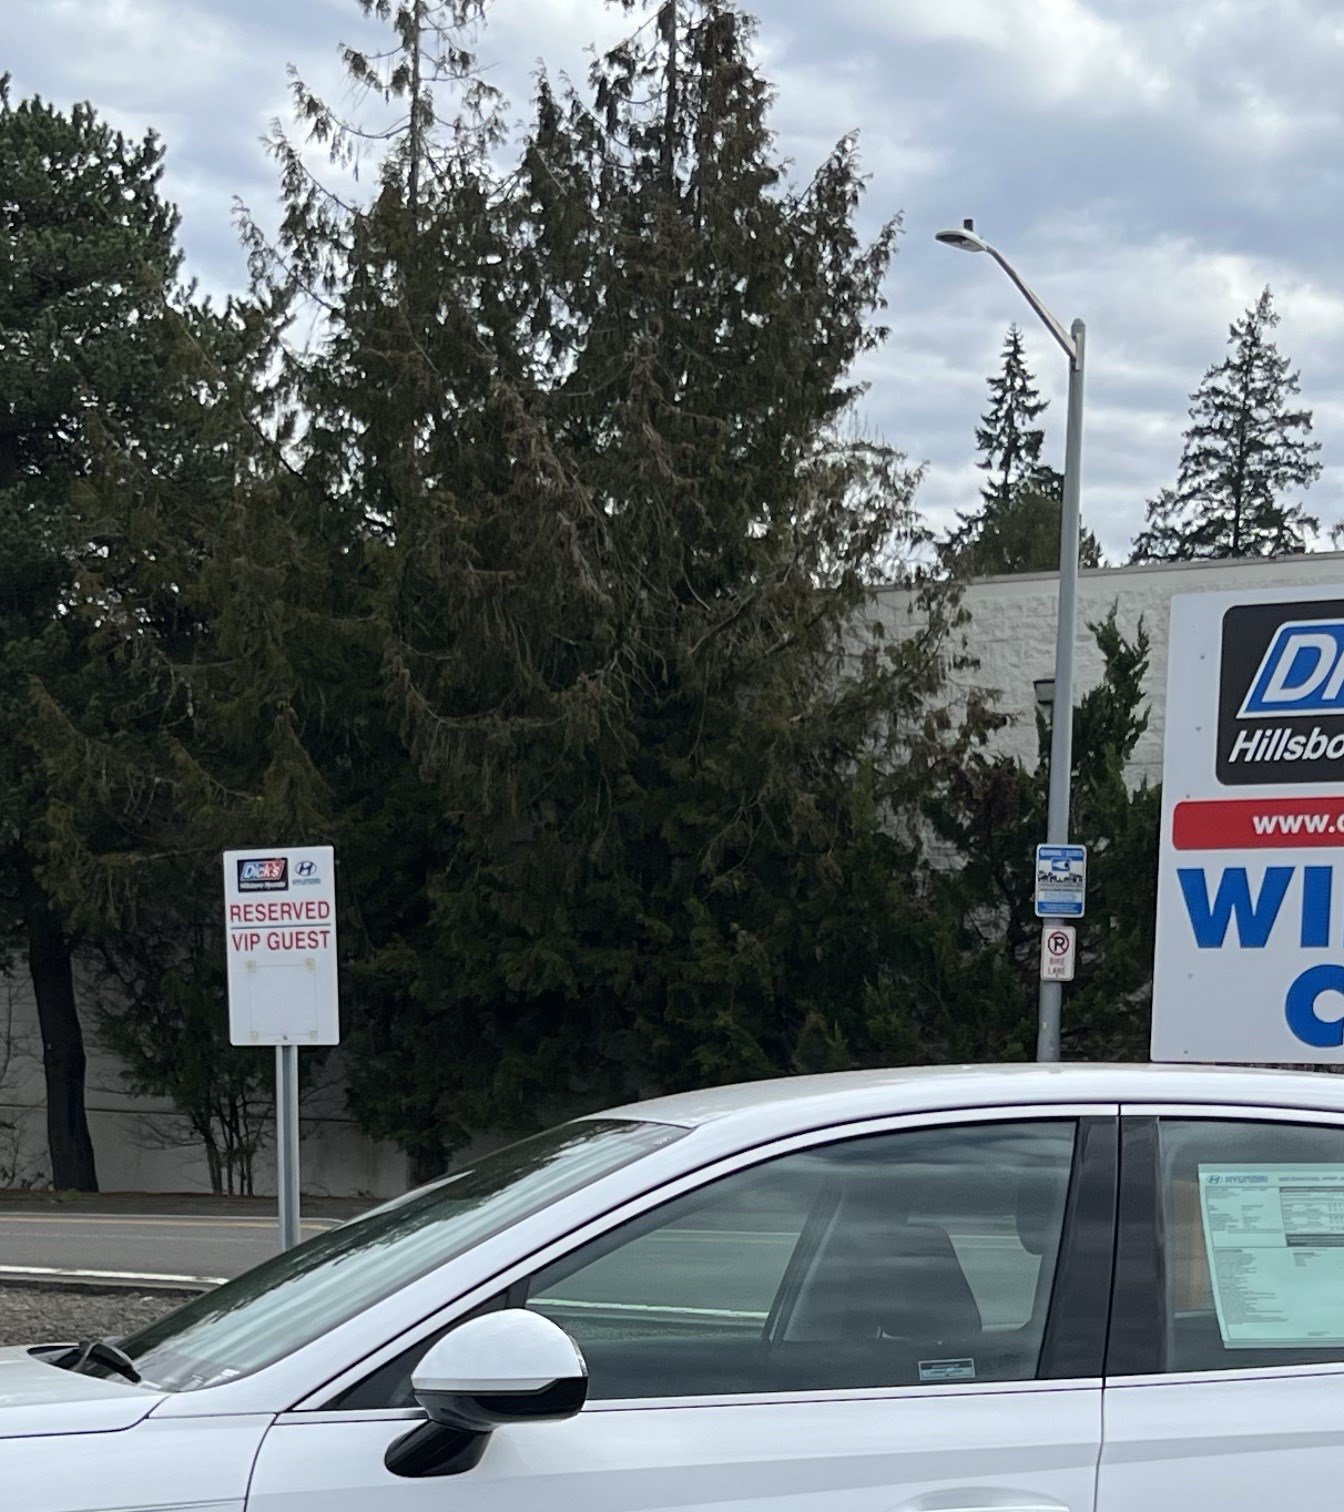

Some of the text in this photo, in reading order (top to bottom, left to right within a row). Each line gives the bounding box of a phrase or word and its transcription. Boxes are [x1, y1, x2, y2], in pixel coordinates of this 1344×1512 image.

[229, 901, 331, 923] RESERVED
[231, 930, 331, 952] VIP GUEST
